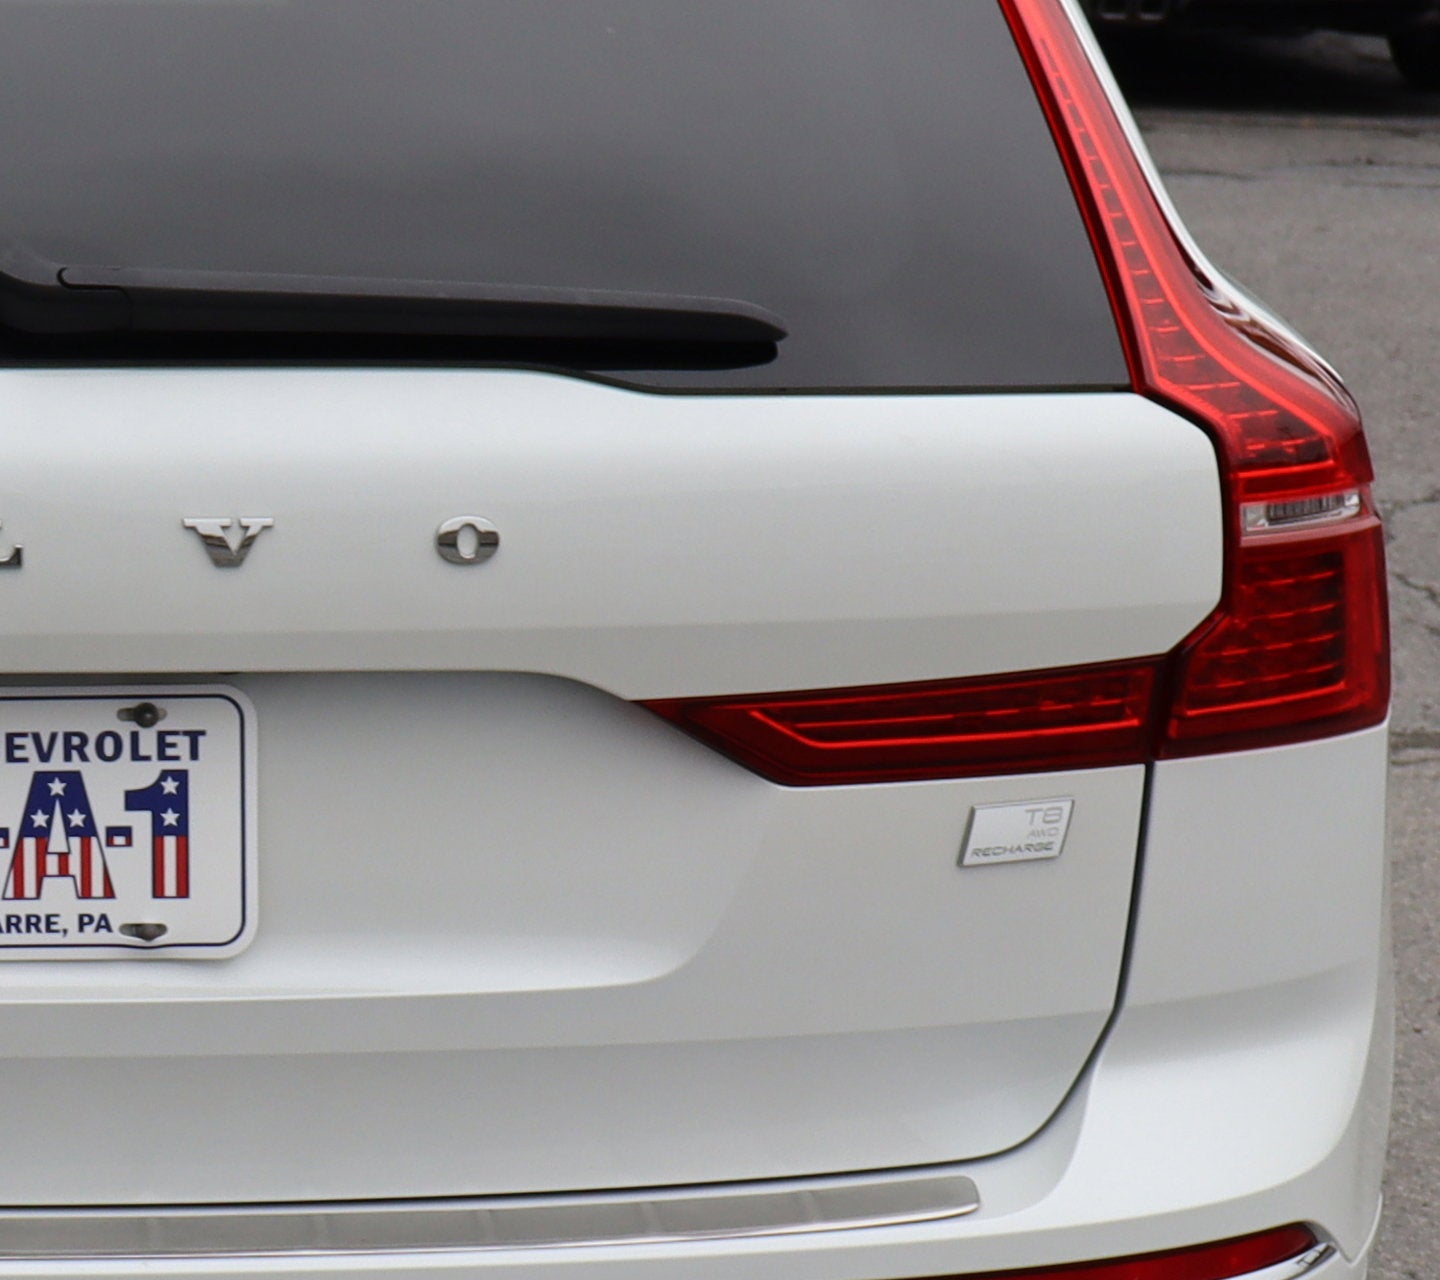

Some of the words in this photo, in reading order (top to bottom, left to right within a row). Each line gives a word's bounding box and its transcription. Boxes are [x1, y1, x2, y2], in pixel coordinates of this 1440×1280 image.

[1024, 807, 1062, 825] T8
[1028, 827, 1060, 838] AWD
[971, 841, 1054, 857] RECHARGE
[77, 914, 113, 934] PA
